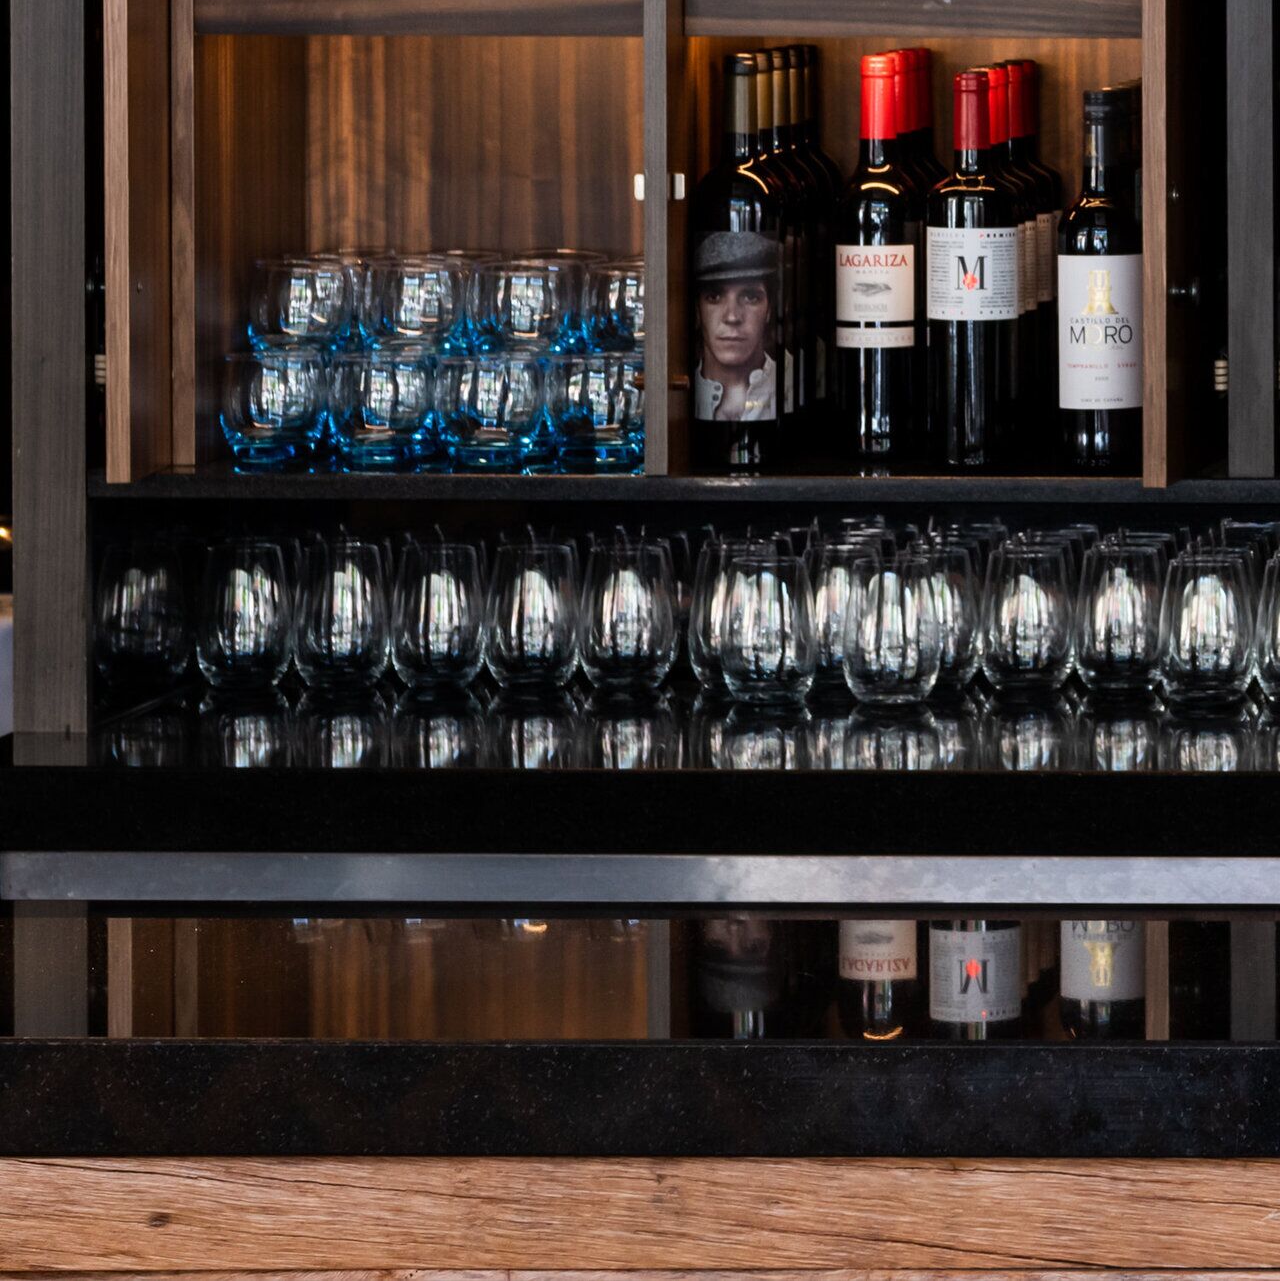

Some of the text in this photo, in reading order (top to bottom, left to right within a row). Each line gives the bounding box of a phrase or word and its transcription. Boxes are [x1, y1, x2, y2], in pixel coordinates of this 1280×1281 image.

[839, 253, 908, 268] LAGARIZA
[954, 255, 988, 291] M
[1070, 317, 1111, 325] CASTILLO
[1070, 324, 1133, 345] MORO
